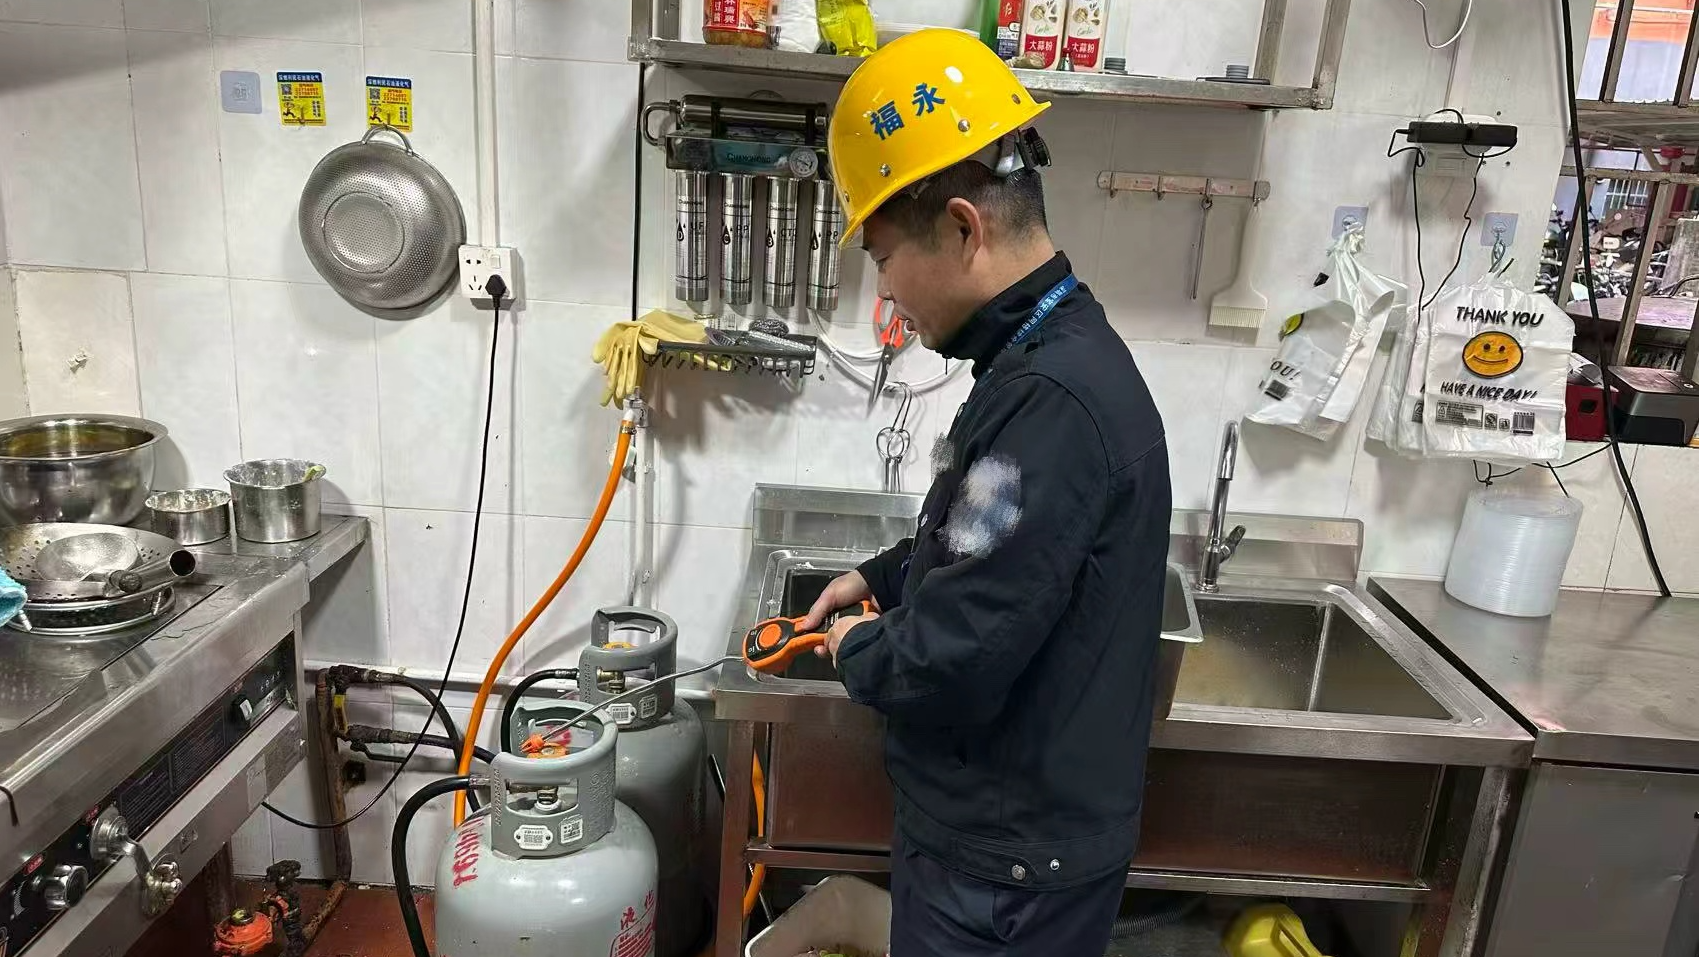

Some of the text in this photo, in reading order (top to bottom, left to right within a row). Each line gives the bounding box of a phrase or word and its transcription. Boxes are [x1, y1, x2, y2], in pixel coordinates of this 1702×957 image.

[1029, 40, 1053, 52] 大蒜粉
[1072, 42, 1095, 54] 大蒜粉
[870, 82, 946, 140] 福永
[1456, 306, 1544, 327] THANK YOU
[1270, 360, 1302, 380] OU!
[1440, 381, 1538, 402] HAVE A NICE DAY!
